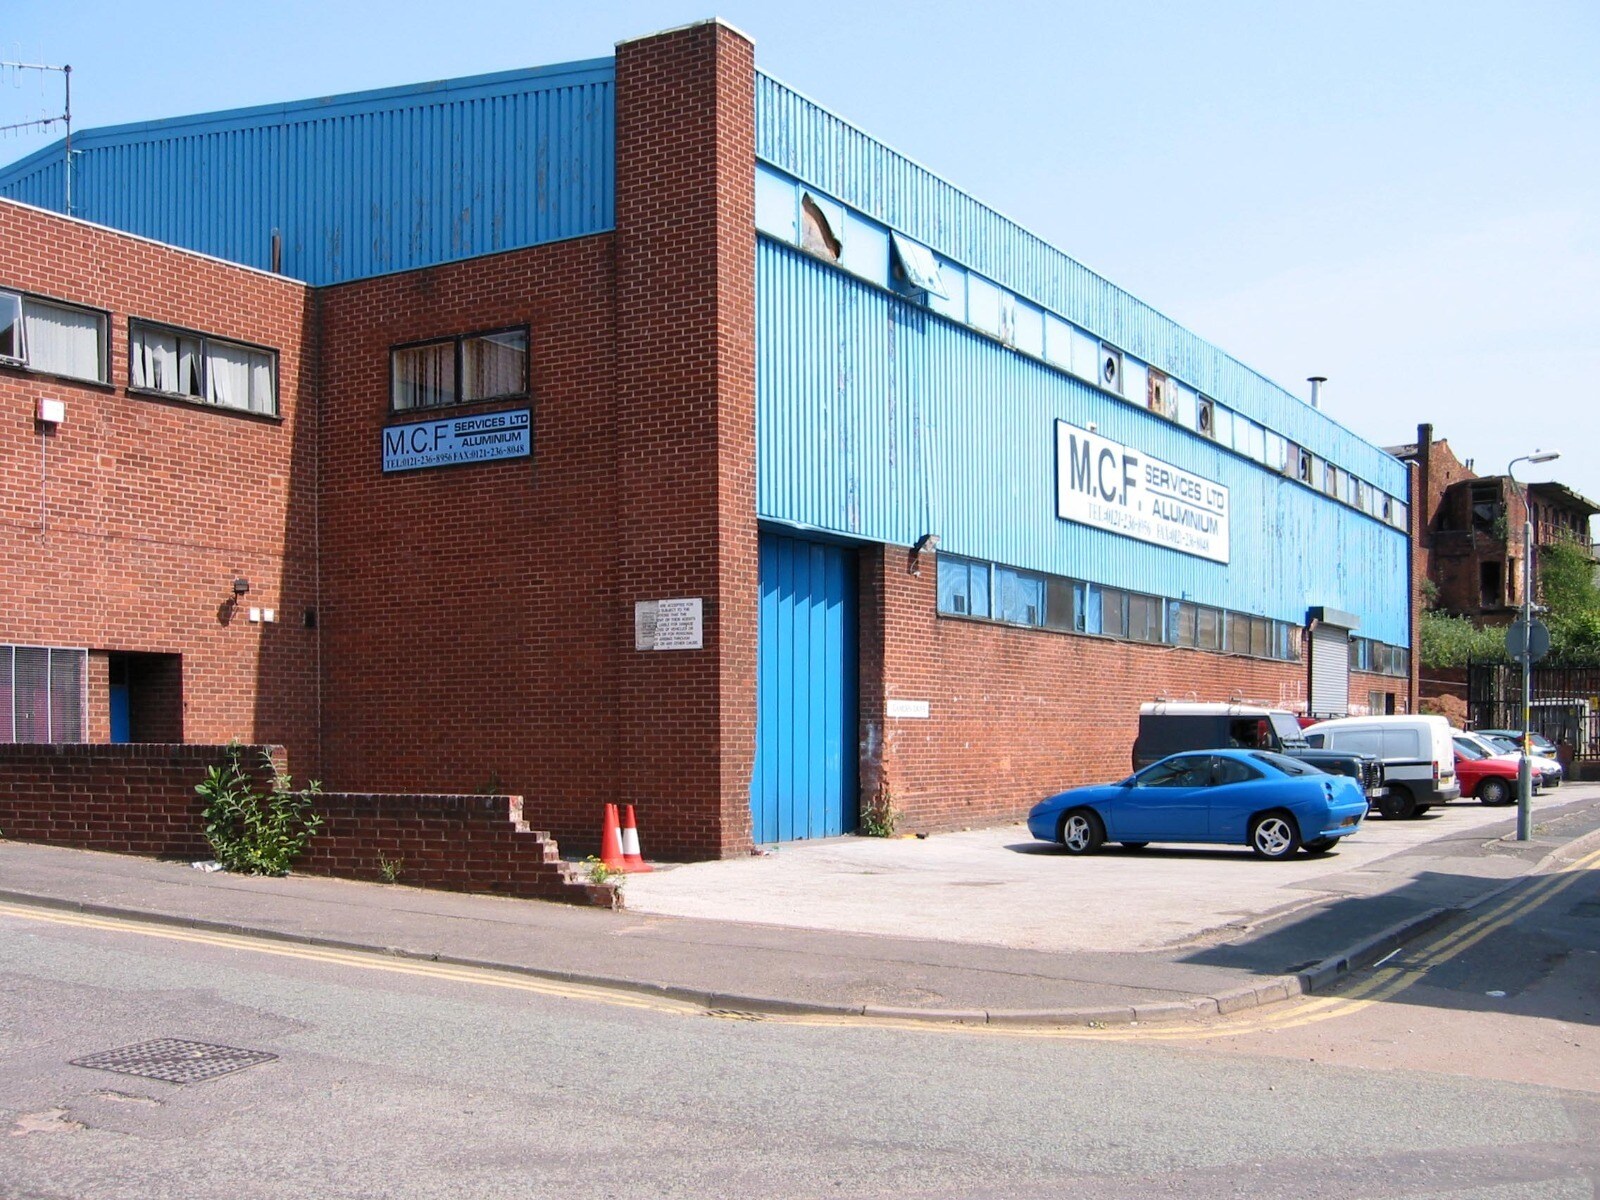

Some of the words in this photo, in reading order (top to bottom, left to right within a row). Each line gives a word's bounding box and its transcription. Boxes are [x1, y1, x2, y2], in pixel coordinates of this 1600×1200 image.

[385, 424, 453, 456] M.C.F.
[454, 416, 506, 432] SERVICES
[509, 414, 529, 424] LTD
[461, 431, 522, 447] ALUMINIUM
[1069, 433, 1142, 511] M.C.F.
[1145, 464, 1202, 501] SERVICES
[1206, 487, 1224, 510] LTD
[1152, 498, 1219, 536] ALUMINIUM
